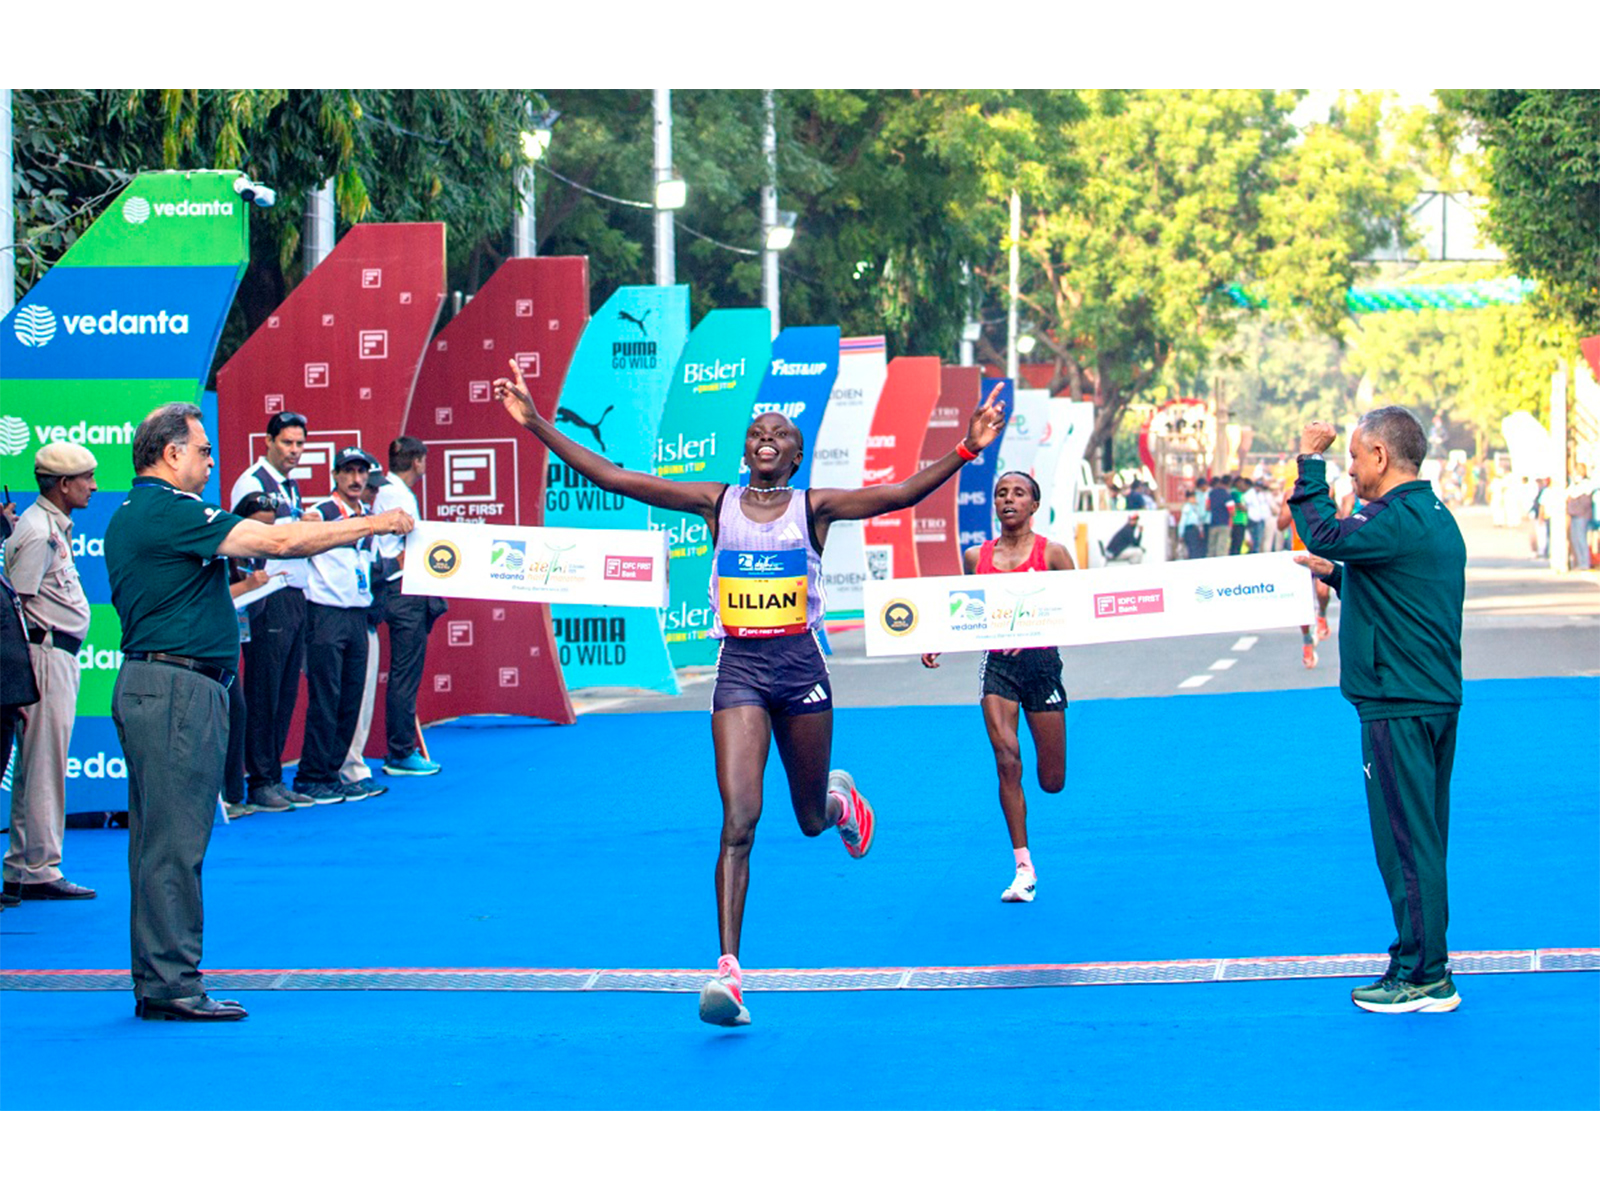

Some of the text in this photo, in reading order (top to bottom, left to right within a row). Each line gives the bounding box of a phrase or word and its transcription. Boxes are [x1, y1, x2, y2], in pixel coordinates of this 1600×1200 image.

[153, 199, 233, 217] vedanta
[62, 309, 189, 335] vedanta
[612, 341, 657, 356] PUMA
[612, 357, 657, 369] GO WILD
[684, 358, 746, 383] Bisleri
[35, 420, 136, 444] vedant
[657, 432, 716, 462] isleri
[546, 490, 625, 511] GO WILD
[437, 503, 505, 516] IDFC FIRST
[651, 518, 708, 545] sler
[959, 532, 987, 545] IMS
[490, 572, 525, 581] vedanta
[825, 573, 866, 585] RIDIEN
[1216, 582, 1274, 596] vedanta
[728, 592, 797, 609] LILIAN
[1118, 594, 1160, 605] IDFC FIRST
[1118, 605, 1138, 613] Bank
[951, 622, 987, 631] vedanta
[560, 645, 626, 666] O WILD
